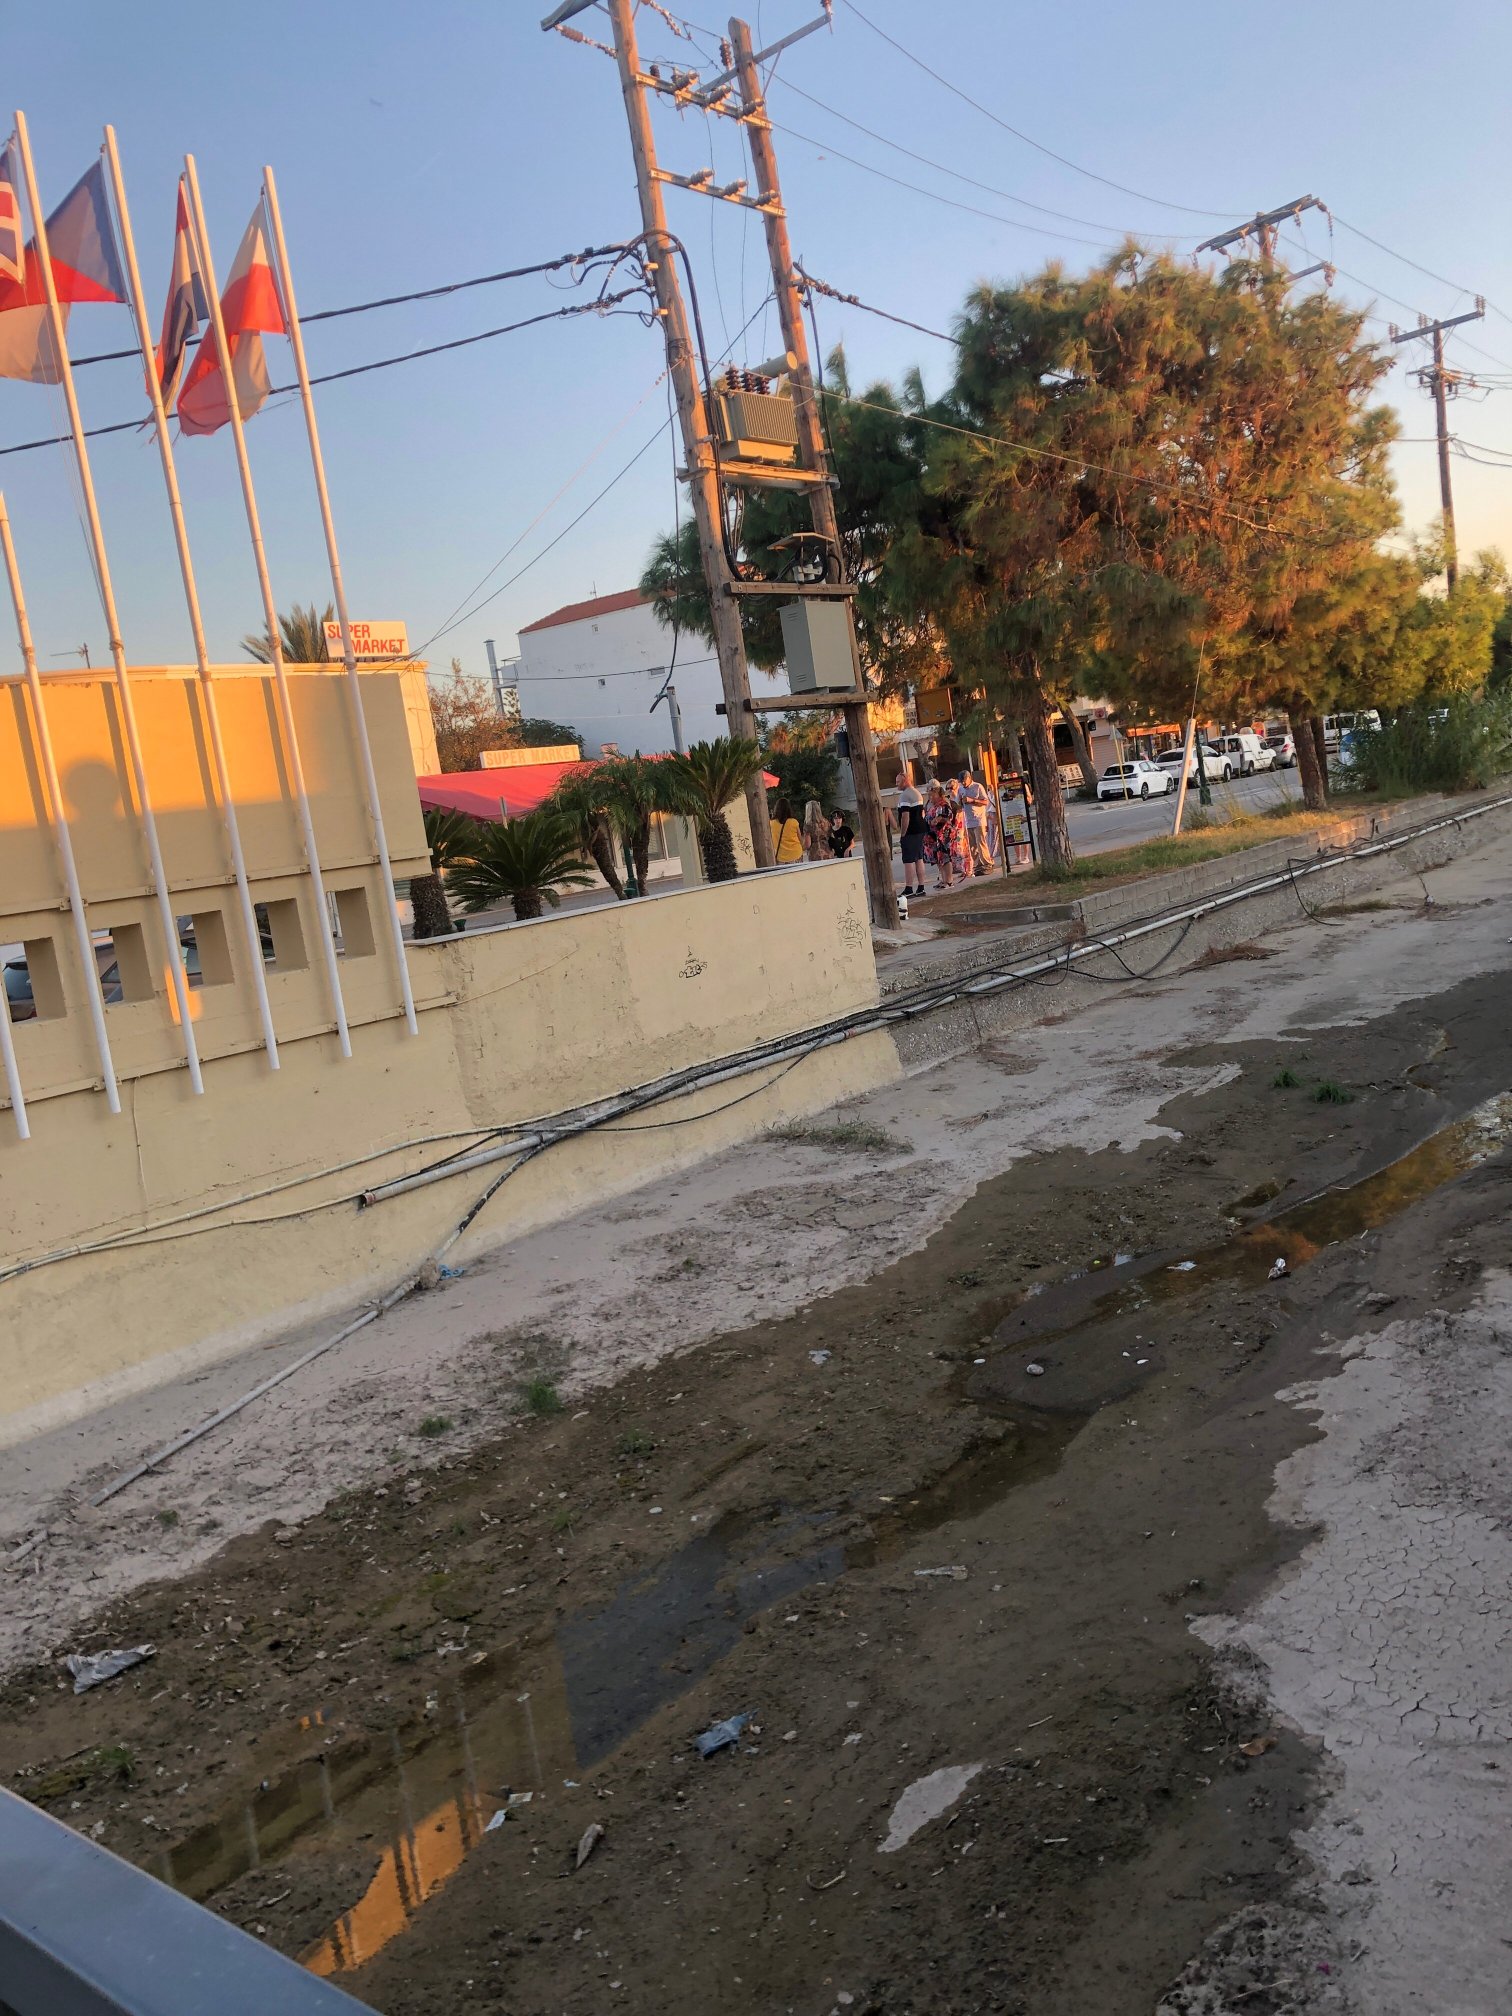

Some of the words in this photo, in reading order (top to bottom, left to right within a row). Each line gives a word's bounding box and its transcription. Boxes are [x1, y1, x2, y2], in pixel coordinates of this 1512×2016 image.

[351, 639, 405, 654] MARKET
[486, 750, 526, 766] SUPER
[531, 746, 577, 763] MARKET
